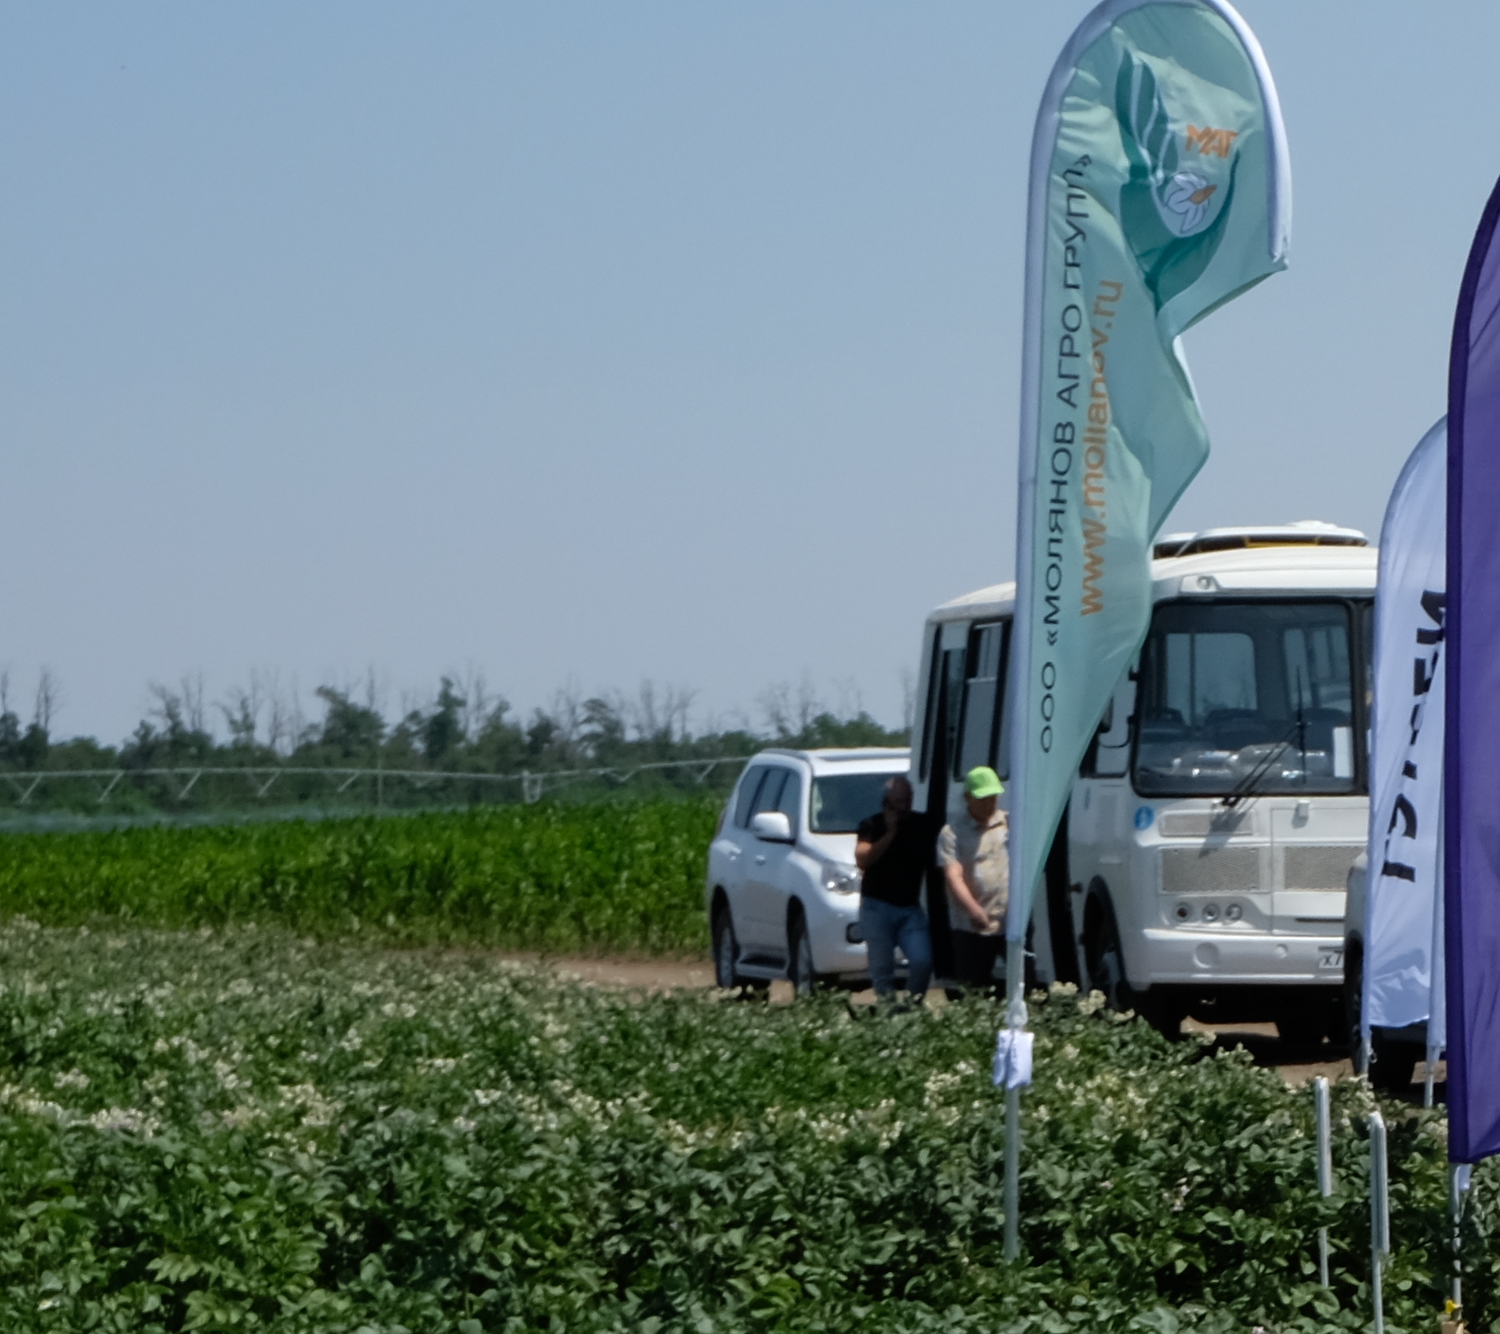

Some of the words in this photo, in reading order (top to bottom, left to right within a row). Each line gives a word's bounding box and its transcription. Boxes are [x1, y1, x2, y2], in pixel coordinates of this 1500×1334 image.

[1056, 303, 1082, 410] АГРО
[1042, 420, 1076, 647] «МОЛЯНОВ
[1040, 659, 1056, 754] ООО
